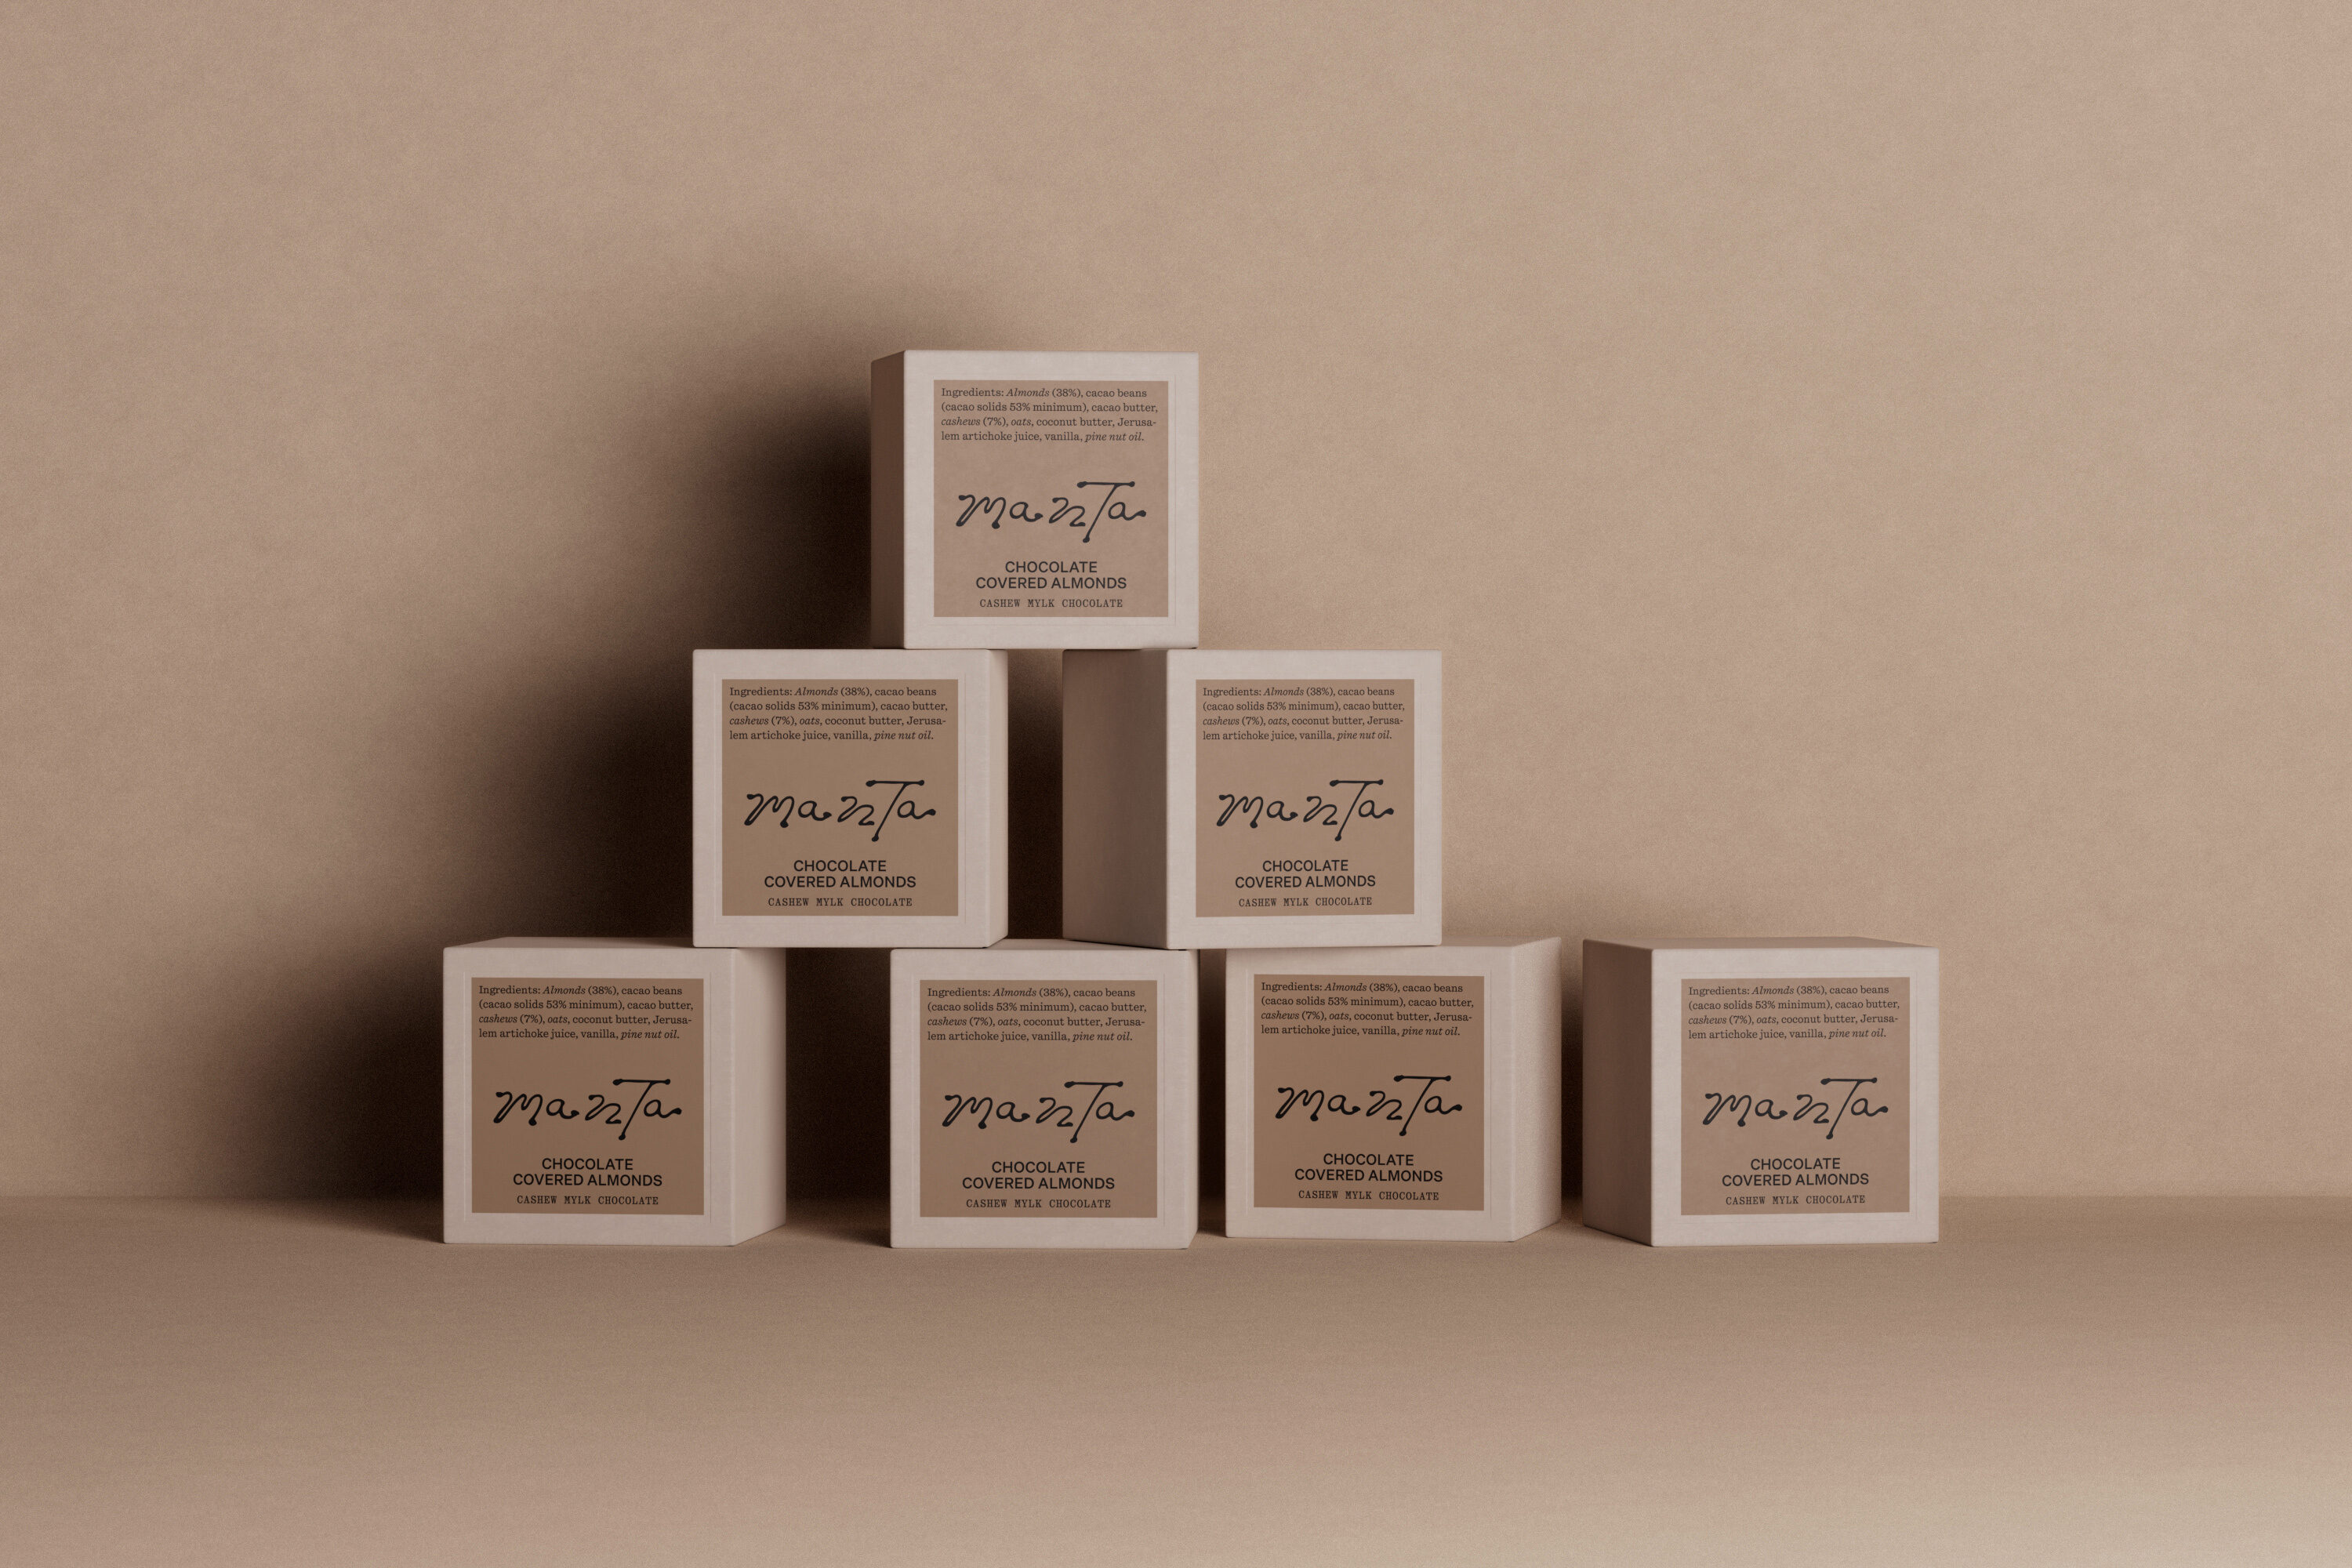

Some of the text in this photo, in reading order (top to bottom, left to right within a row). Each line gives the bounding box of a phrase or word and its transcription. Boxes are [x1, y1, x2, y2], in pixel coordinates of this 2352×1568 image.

[941, 387, 1004, 398] Ingredients:
[1005, 387, 1050, 397] Almonds
[1051, 387, 1083, 398] (38%),
[1116, 388, 1147, 397] beans
[941, 401, 975, 412] (cacao
[976, 401, 1007, 412] solids
[1009, 401, 1030, 412] 53%
[1032, 401, 1089, 413] minimum),
[1122, 402, 1158, 413] butter,
[941, 416, 1156, 427] cashews (7%), oats, coconut butter, Jerusa-
[941, 430, 1144, 443] lem artichoke juice, vanilla, pine nut oil.
[1004, 561, 1098, 573] CHOCOLATE
[975, 576, 1127, 589] COVERED ALMONDS
[979, 598, 1123, 608] CASHEW MYLK CHOCOLATE
[1203, 686, 1261, 698] Ingredients:
[1262, 686, 1304, 696] Almonds
[1305, 686, 1335, 697] (38%),
[1367, 686, 1395, 695] beans
[1203, 701, 1234, 712] (cacao
[1236, 700, 1265, 710] solids
[1266, 701, 1286, 710] 53%
[1287, 700, 1341, 712] minimum),
[1371, 700, 1405, 711] butter,
[729, 715, 946, 726] cashews (7%), oats, coconut butter, Jerusa-
[1202, 715, 1403, 727] cashews (7%), oats, coconut butter, Jerusa-
[1202, 729, 1392, 742] lem artichoke juice, vanilla, pine nut oil.
[793, 859, 887, 872] CHOCOLATE
[1261, 858, 1348, 873] CHOCOLATE
[764, 875, 916, 888] COVERED ALMONDS
[1234, 874, 1376, 888] COVERED ALMONDS
[768, 897, 912, 906] CASHEW MYLK CHOCOLATE
[1238, 896, 1372, 907] CASHEW MYLK CHOCOLATE
[478, 984, 540, 996] Ingredients:
[542, 985, 586, 994] Almonds
[587, 985, 619, 996] (38%),
[652, 985, 682, 995] beans
[1688, 985, 1750, 997] Ingredients:
[1751, 985, 1795, 995] Almonds
[1796, 985, 1827, 996] (38%),
[1860, 984, 1889, 994] beans
[478, 999, 512, 1010] (cacao
[514, 999, 543, 1009] solids
[546, 1000, 567, 1009] 53%
[568, 999, 625, 1011] minimum),
[658, 1000, 693, 1011] butter,
[478, 1013, 691, 1025] cashews (7%), oats, coconut butter, Jerusa-
[927, 1016, 1145, 1027] cashews (7%), oats, coconut butter, Jerusa-
[1261, 1010, 1472, 1022] cashews (7%), oats, coconut butter, Jerusa-
[1688, 1013, 1898, 1025] cashews (7%), oats, coconut butter, Jerusa-
[478, 1028, 680, 1040] lem artichoke juice, vanilla, pine nut oil.
[541, 1157, 633, 1171] CHOCOLATE
[1323, 1152, 1414, 1167] CHOCOLATE
[1750, 1156, 1841, 1171] CHOCOLATE
[991, 1160, 1085, 1174] CHOCOLATE
[513, 1173, 662, 1187] COVERED ALMONDS
[1294, 1167, 1443, 1182] COVERED ALMONDS
[1721, 1172, 1869, 1187] COVERED ALMONDS
[961, 1176, 1115, 1189] COVERED ALMONDS
[516, 1194, 659, 1205] CASHEW MYLK CHOCOLATE
[1298, 1189, 1439, 1200] CASHEW MYLK CHOCOLATE
[1725, 1194, 1865, 1205] CASHEW MYLK CHOCOLATE
[965, 1198, 1111, 1208] CASHEW MYLK CHOCOLATE
